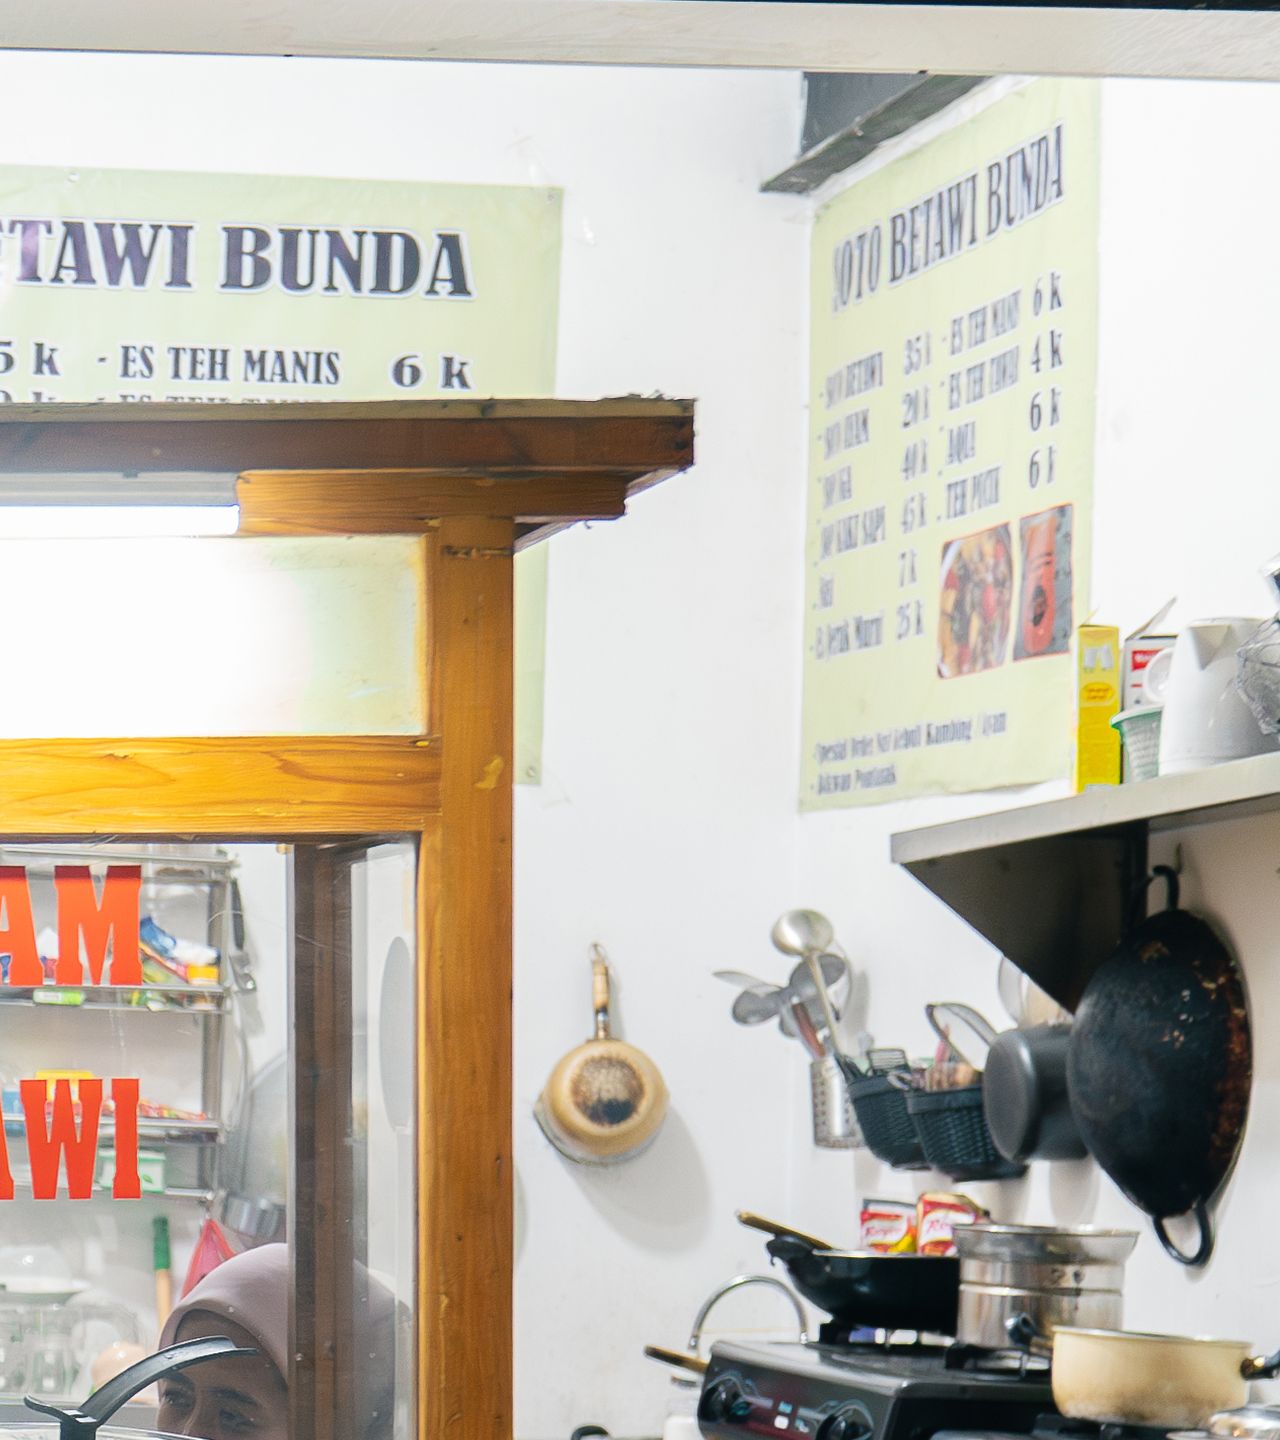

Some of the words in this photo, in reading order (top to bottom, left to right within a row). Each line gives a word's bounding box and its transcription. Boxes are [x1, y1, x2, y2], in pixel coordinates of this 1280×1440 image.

[889, 172, 978, 283] BETAWI
[987, 124, 1063, 236] BUNDA
[220, 225, 473, 298] BUNDA
[1033, 278, 1042, 316] 6
[120, 345, 155, 379] ES
[167, 346, 230, 381] TEH
[244, 349, 340, 385] MANIS
[392, 354, 423, 388] 6
[1030, 392, 1041, 431] 6
[1029, 450, 1040, 488] 6
